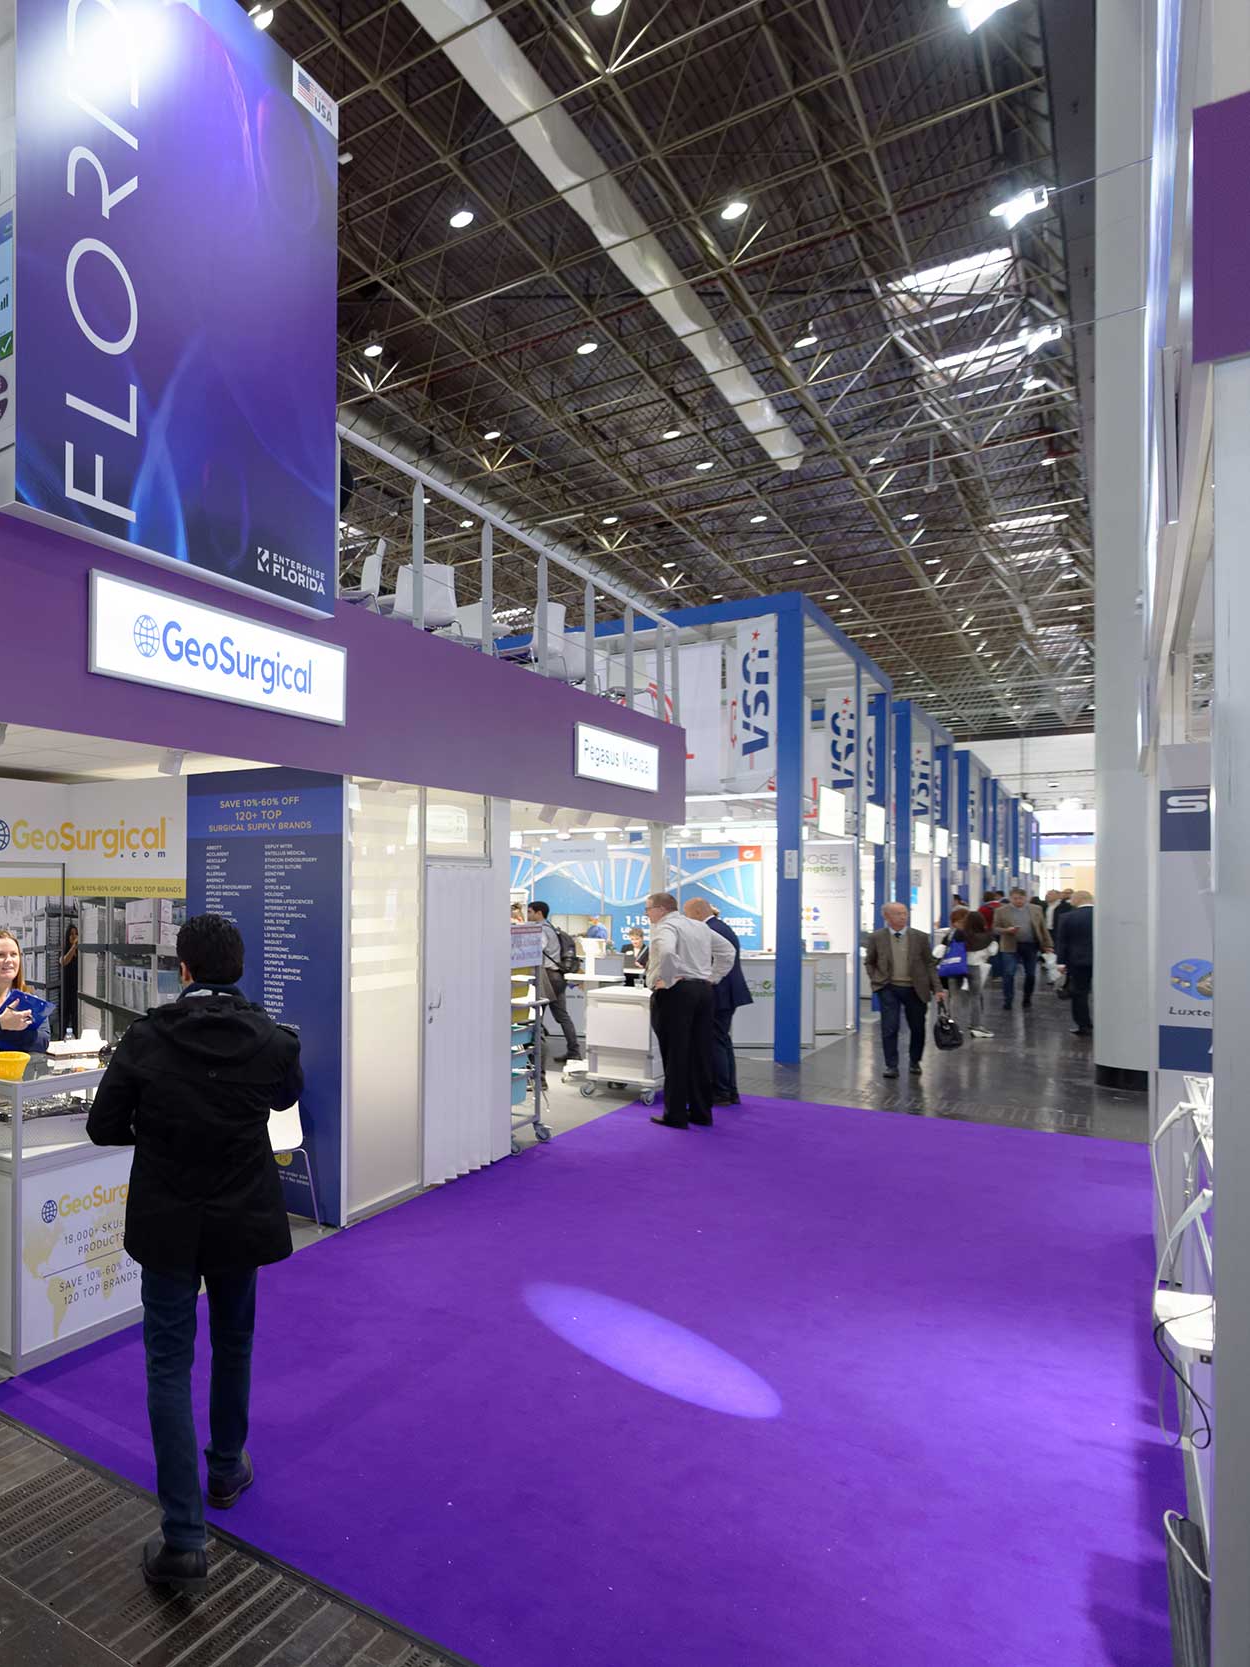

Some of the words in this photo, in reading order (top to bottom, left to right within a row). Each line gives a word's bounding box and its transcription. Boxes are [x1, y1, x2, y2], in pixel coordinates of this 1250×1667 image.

[314, 97, 333, 127] USA
[272, 553, 326, 581] ENTERPRISE
[272, 564, 326, 596] FLORIDA
[162, 620, 312, 695] GeoSurgical
[742, 649, 769, 757] USA
[220, 800, 240, 809] SAVE
[243, 798, 279, 807] 10%-60%
[281, 796, 299, 805] OFF
[208, 824, 244, 832] SURGICAL
[247, 823, 276, 831] SUPPLY
[278, 821, 312, 830] BRANDS
[235, 812, 258, 821] 120+
[261, 810, 282, 819] TOP
[12, 816, 166, 859] GeoSurgical
[806, 853, 838, 865] OSE
[625, 915, 650, 927] 1,15
[1169, 1007, 1213, 1018] Luxte
[64, 1227, 98, 1245] 18,000+
[77, 1232, 125, 1255] PRODUCTS
[59, 1275, 82, 1293] SAVE
[86, 1263, 122, 1282] 10%-60%
[63, 1292, 79, 1305] 120
[82, 1286, 100, 1299] TOP
[103, 1270, 138, 1290] BRANDS
